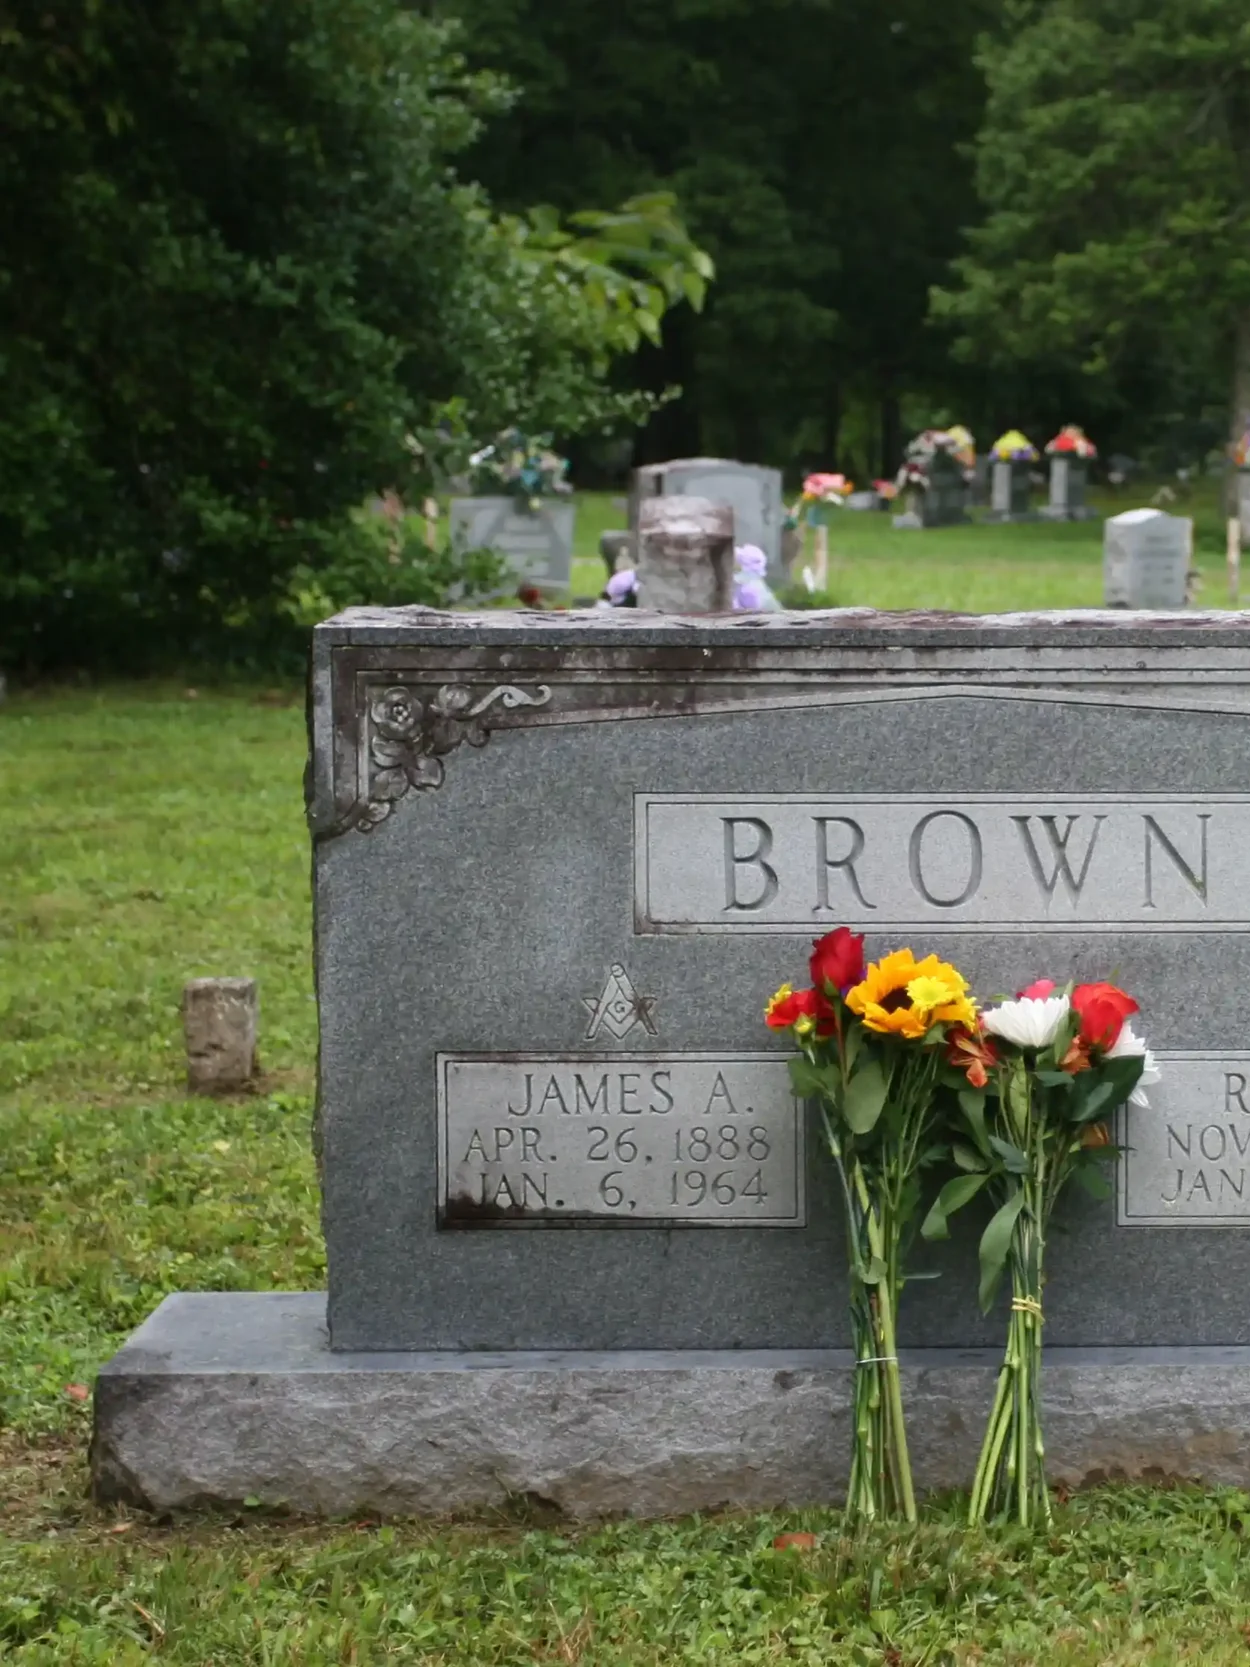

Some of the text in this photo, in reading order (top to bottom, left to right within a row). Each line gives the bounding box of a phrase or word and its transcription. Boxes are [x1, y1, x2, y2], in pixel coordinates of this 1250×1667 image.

[719, 810, 1213, 912] BROWN
[507, 1071, 755, 1116] JAMES A.
[463, 1125, 771, 1166] APR. 26, 1888
[478, 1169, 768, 1210] JAN. 6, 1964
